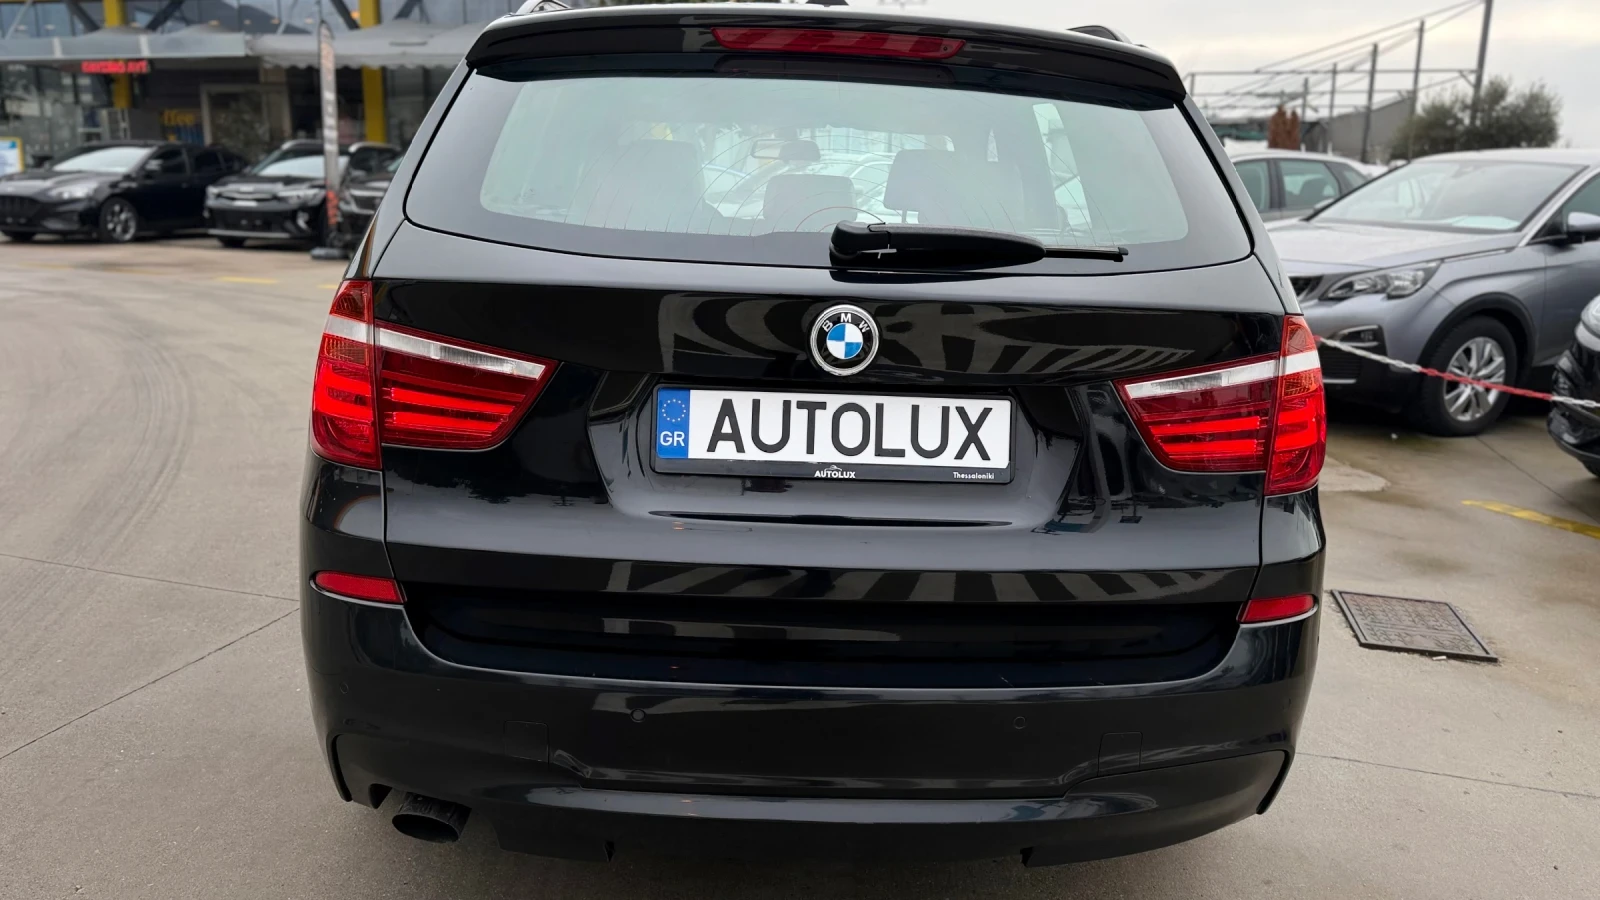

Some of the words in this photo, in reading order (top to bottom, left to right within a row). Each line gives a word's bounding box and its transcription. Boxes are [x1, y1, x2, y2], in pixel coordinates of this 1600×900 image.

[822, 313, 870, 332] BMW
[706, 398, 993, 461] AUTOLUX
[659, 431, 685, 447] GR
[814, 470, 856, 479] AUTOLUX
[952, 472, 995, 480] Thessaloniki
